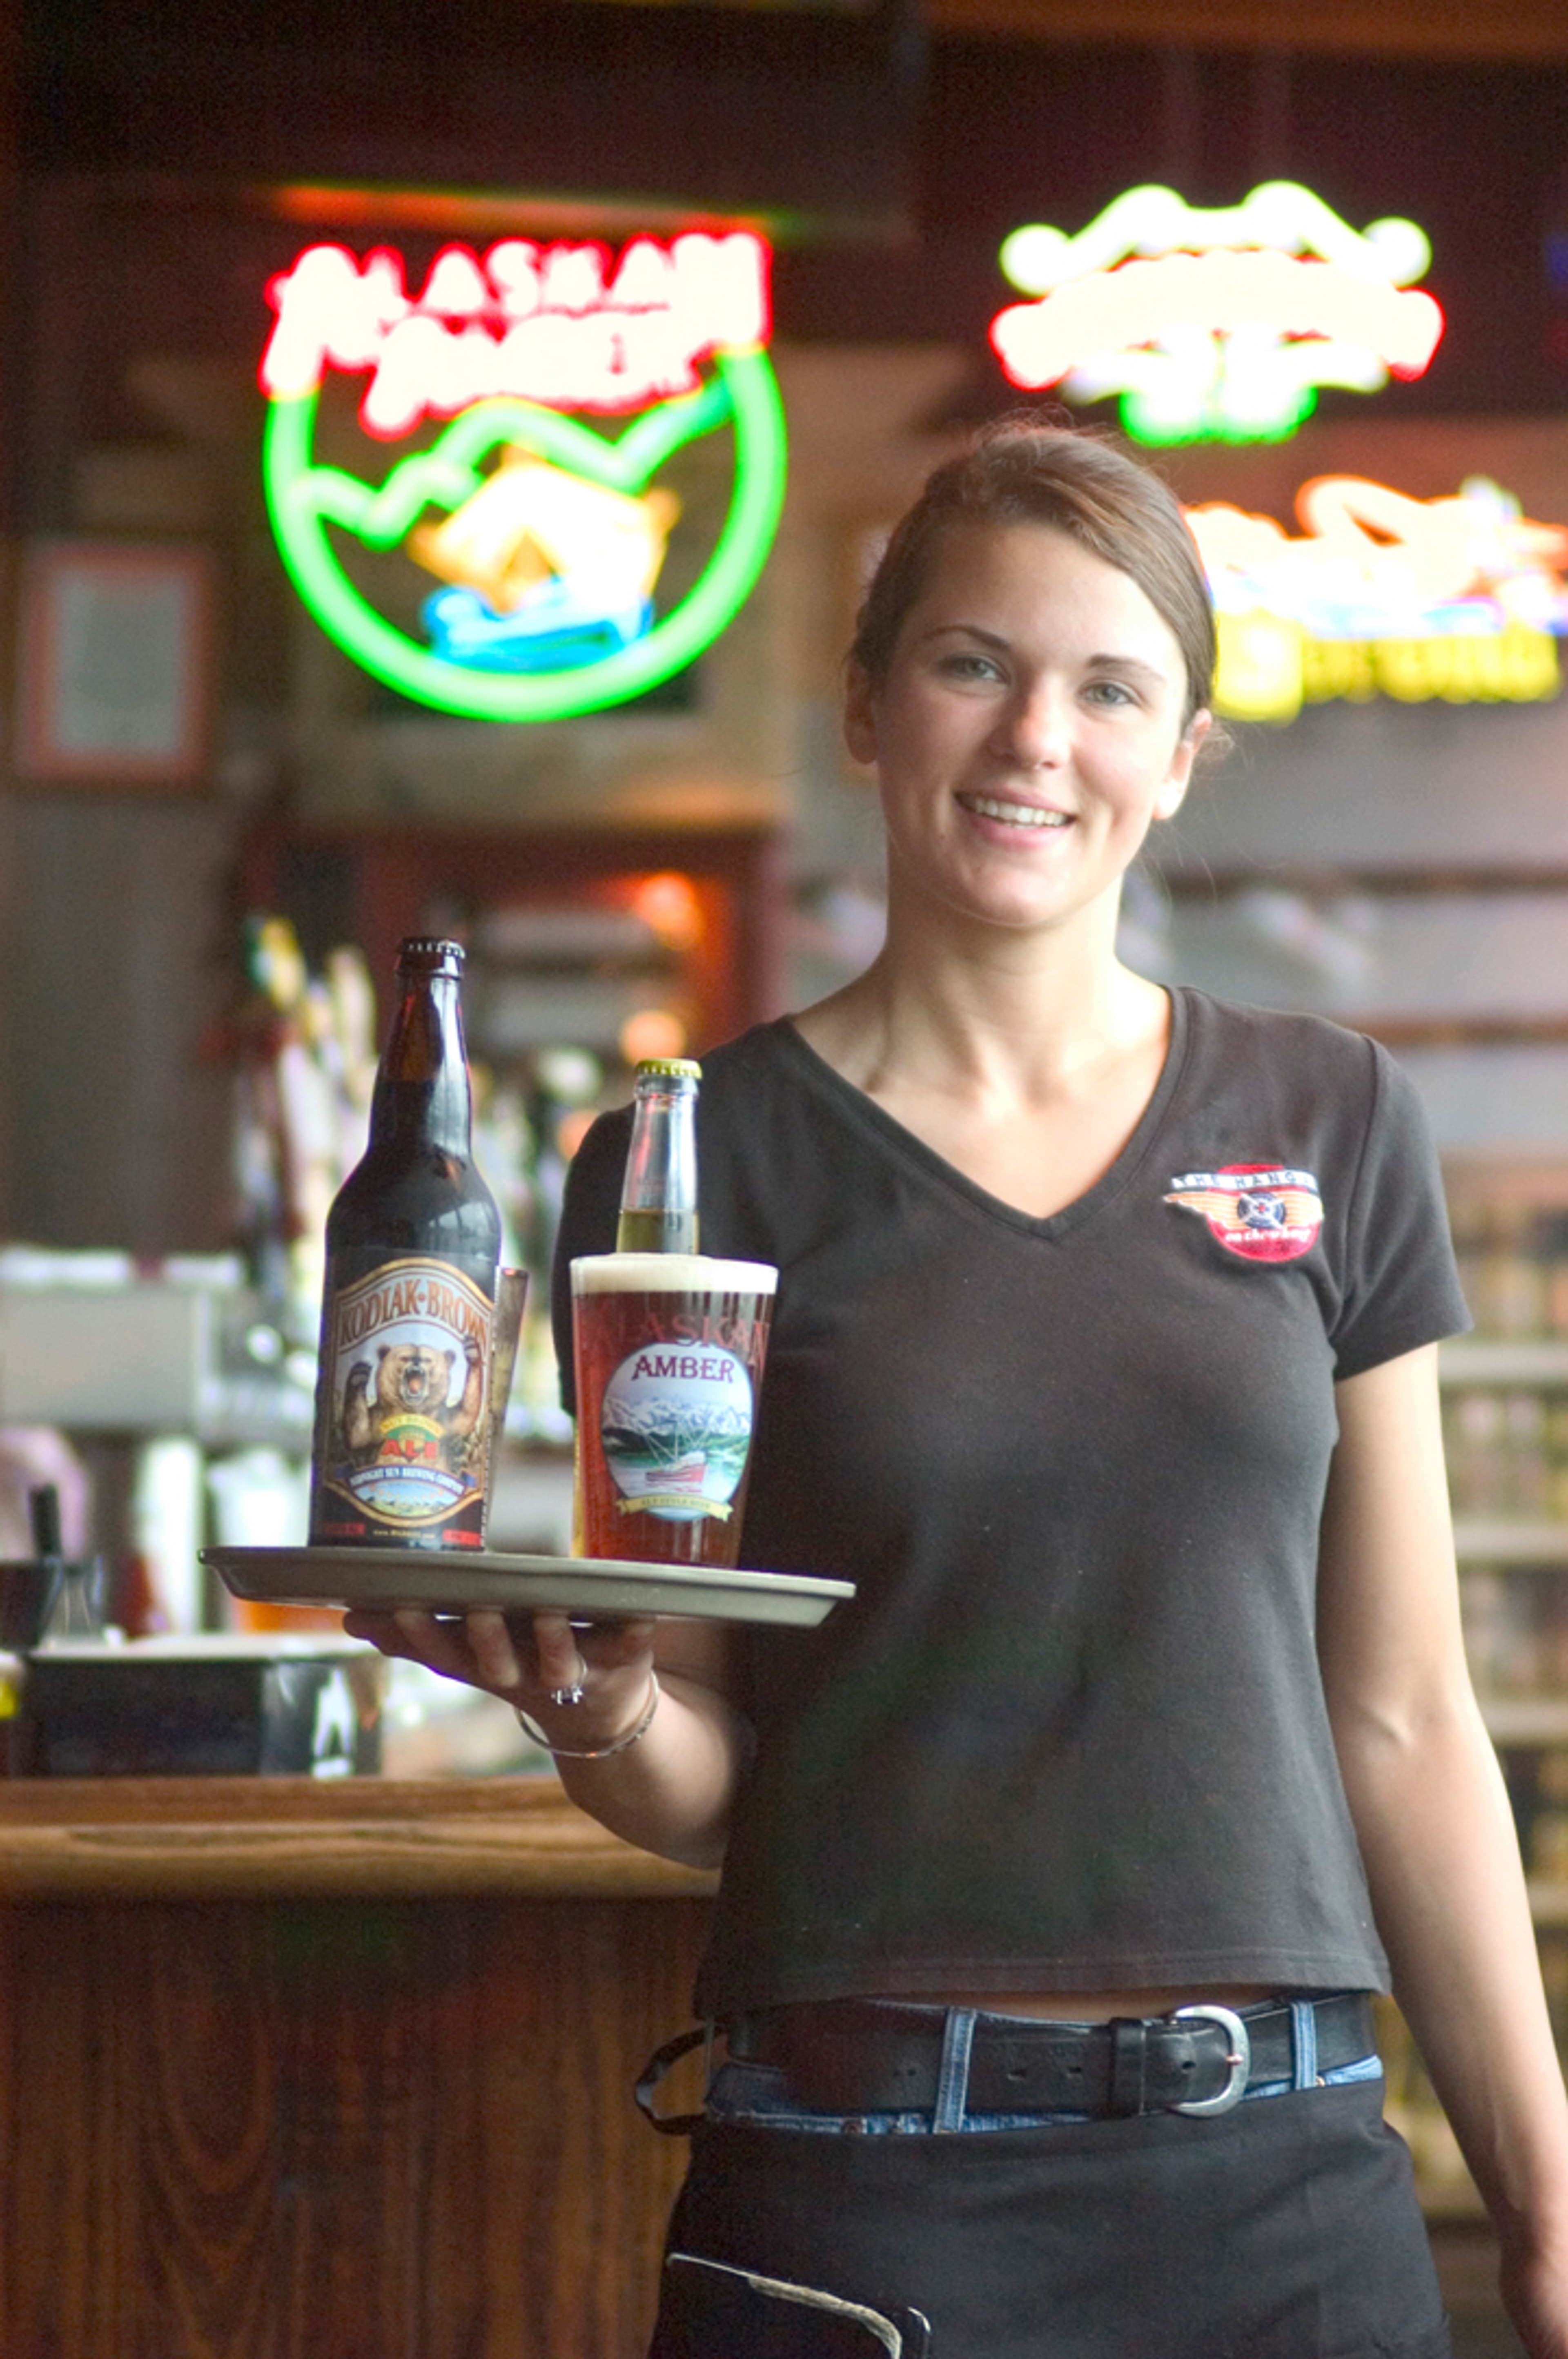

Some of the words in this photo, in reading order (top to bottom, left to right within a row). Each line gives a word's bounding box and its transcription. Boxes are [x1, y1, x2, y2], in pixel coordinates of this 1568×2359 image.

[340, 1279, 421, 1347] KODIAK
[631, 1355, 735, 1383] AMBER
[381, 1439, 437, 1460] ALE
